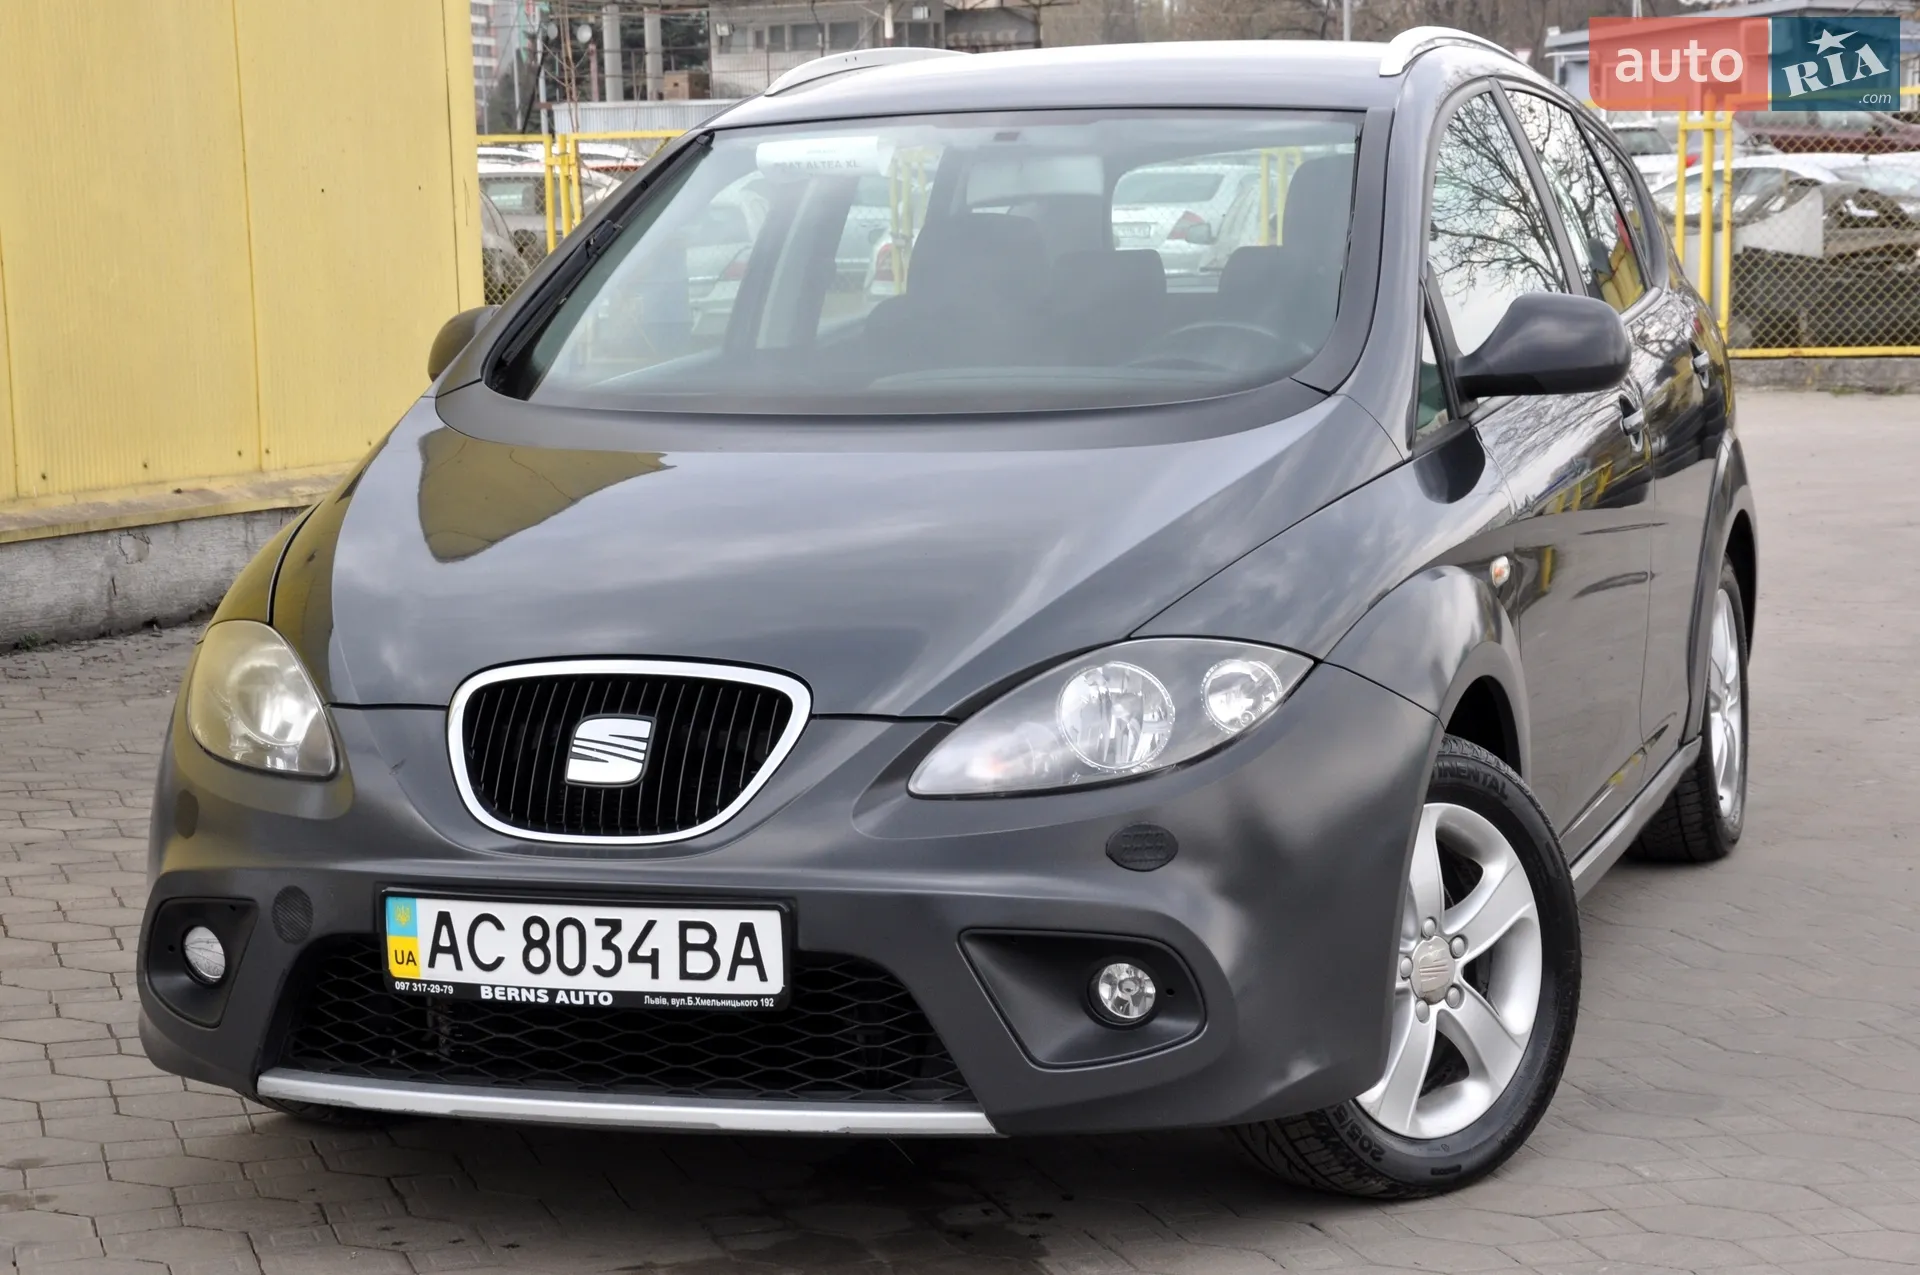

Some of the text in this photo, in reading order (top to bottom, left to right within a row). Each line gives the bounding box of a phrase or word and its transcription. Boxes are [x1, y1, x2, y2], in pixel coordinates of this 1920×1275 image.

[773, 161, 801, 170] AT
[428, 911, 768, 982] AC 8034 BA
[394, 949, 417, 966] UA
[395, 981, 454, 995] 097 317-29-79
[480, 985, 613, 1006] BERNS AUTO
[644, 995, 669, 1006] Львів,
[760, 998, 774, 1007] 192
